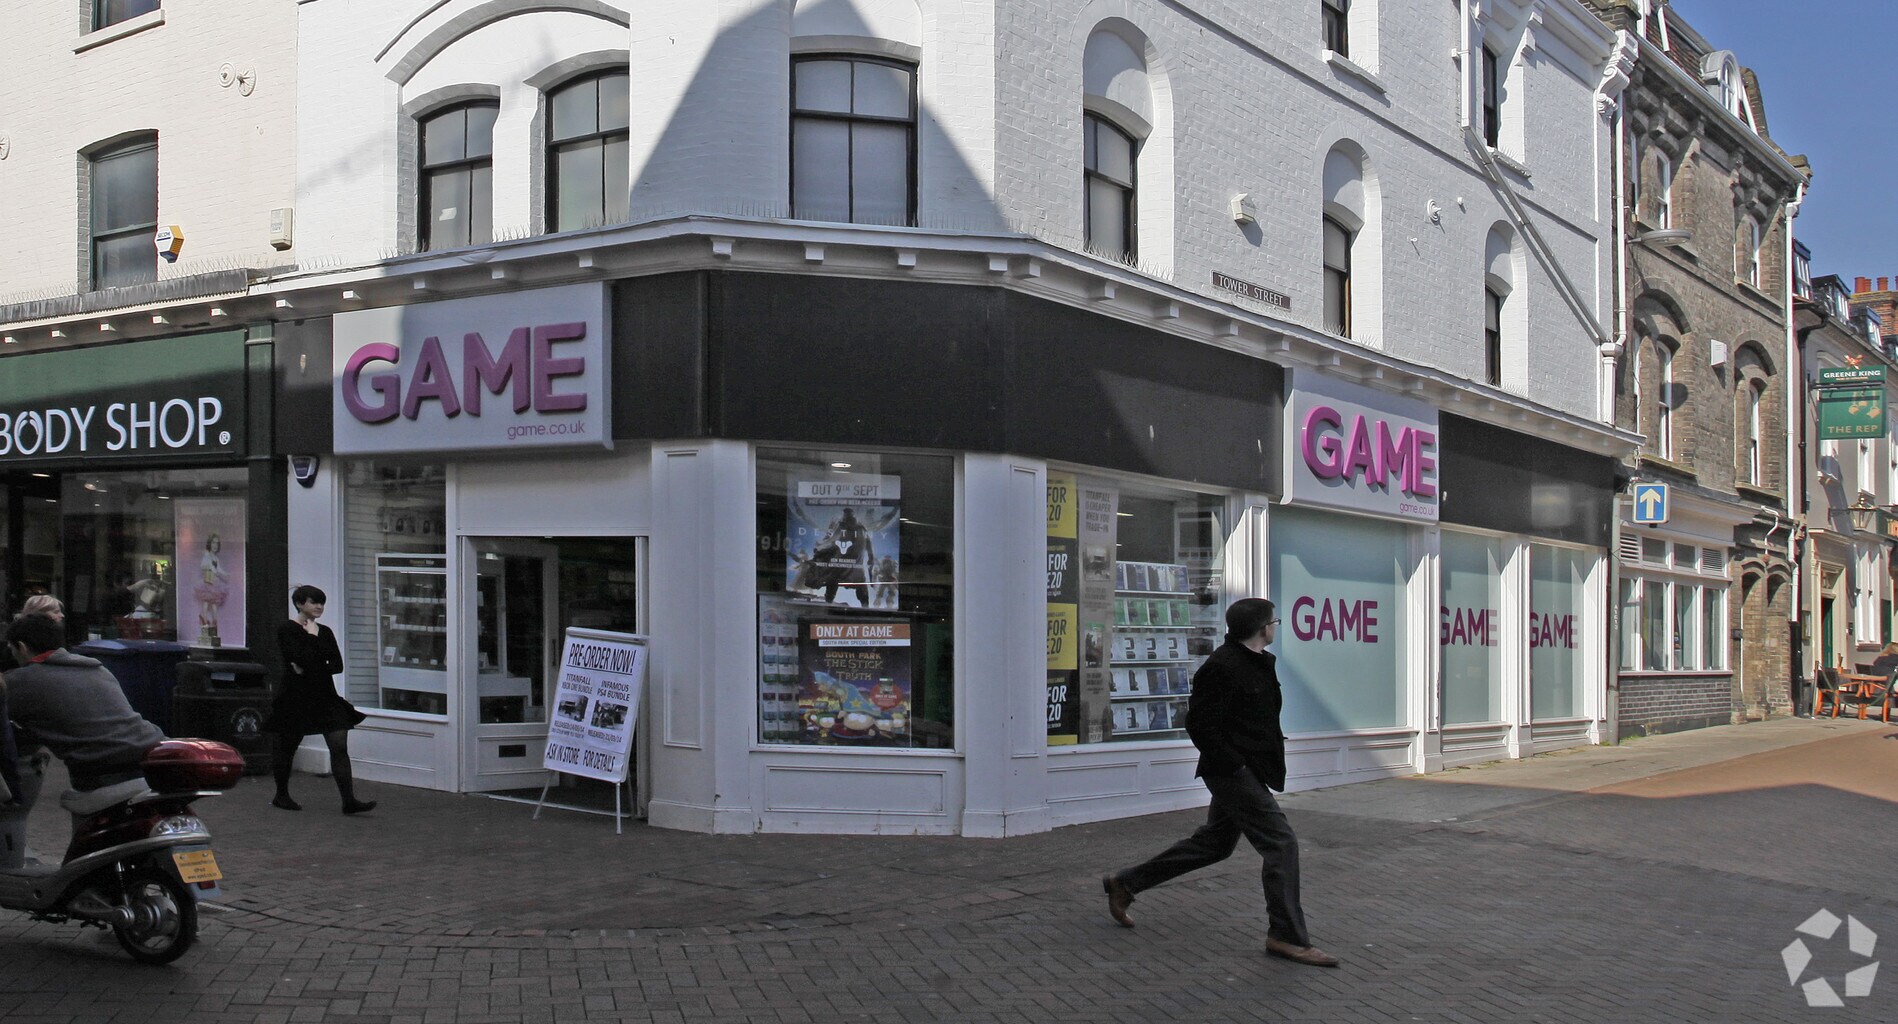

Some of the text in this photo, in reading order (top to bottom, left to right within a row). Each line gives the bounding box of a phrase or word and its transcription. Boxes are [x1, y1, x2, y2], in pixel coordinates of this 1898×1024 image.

[1218, 275, 1284, 306] TOWER STREET
[342, 321, 588, 425] GAME
[507, 421, 586, 440] game.co.uk
[1827, 425, 1879, 433] THE REP
[1301, 405, 1436, 497] GAME
[811, 484, 833, 495] OUT
[853, 485, 879, 496] SEPT
[1047, 486, 1067, 503] FOR
[1047, 504, 1061, 521] 20
[1400, 503, 1435, 516] game.co.uk
[798, 527, 888, 539] DESTINY
[1048, 553, 1068, 571] FOR
[1047, 619, 1067, 637] FOR
[1291, 596, 1378, 643] GAME
[1441, 606, 1497, 647] GAME
[816, 625, 893, 638] ONLY AT GAME
[1530, 612, 1578, 649] GAME
[567, 642, 636, 674] PRE-ORDER NOW!
[825, 650, 856, 658] SOUTH
[823, 658, 884, 670] THE STICK
[566, 673, 591, 685] TITANFALL
[835, 670, 872, 681] TRUTH
[601, 680, 629, 692] INFAMOUS
[1047, 685, 1067, 703] FOR
[607, 690, 631, 701] BUNDLE
[546, 743, 615, 772] ASK IN STORE FOR DETAILS
